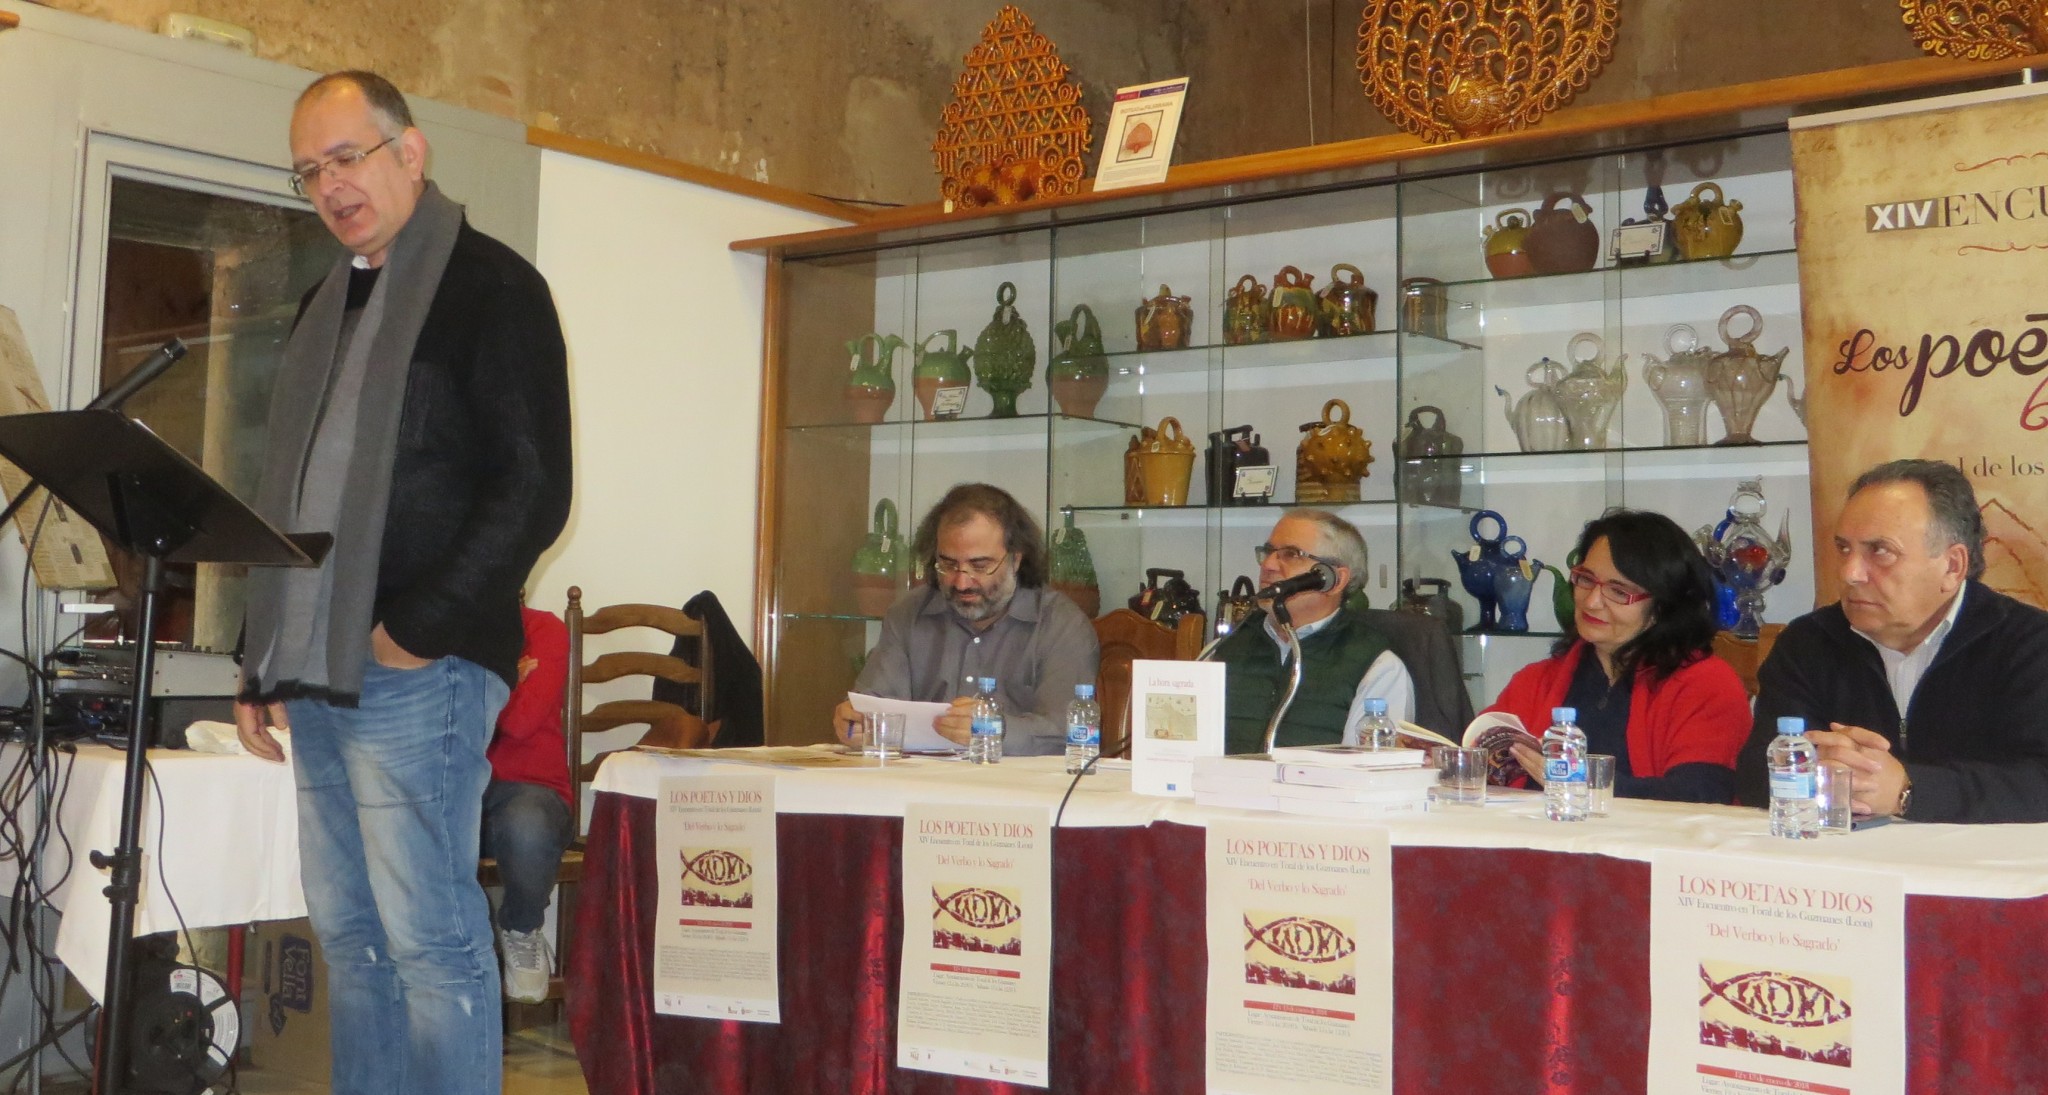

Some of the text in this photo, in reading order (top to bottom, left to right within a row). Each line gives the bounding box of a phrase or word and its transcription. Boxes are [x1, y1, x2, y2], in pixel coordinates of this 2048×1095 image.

[1871, 200, 1933, 231] XIV
[1833, 328, 1913, 375] Los
[1899, 313, 2048, 417] poe
[1973, 456, 2002, 478] de
[2011, 455, 2045, 476] los
[670, 790, 762, 804] LOS POETAS Y DIOS
[920, 819, 1033, 838] LOS POETAS Y DIOS
[1226, 838, 1370, 862] LOS POETAS Y DIOS
[1267, 879, 1293, 892] Verbo
[1301, 882, 1310, 894] lo
[1678, 875, 1873, 914] LOS POETAS Y DIOS
[1677, 896, 1694, 907] XIV
[1697, 898, 1737, 913] Encuentro
[1737, 905, 1748, 914] en
[1750, 905, 1772, 917] Toral
[1774, 908, 1784, 918] de
[1786, 909, 1797, 920] los
[1799, 911, 1843, 926] Guzmanes
[1732, 925, 1767, 943] Verbo
[1767, 934, 1775, 946] y
[1778, 931, 1789, 945] lo
[283, 946, 297, 999] Vella
